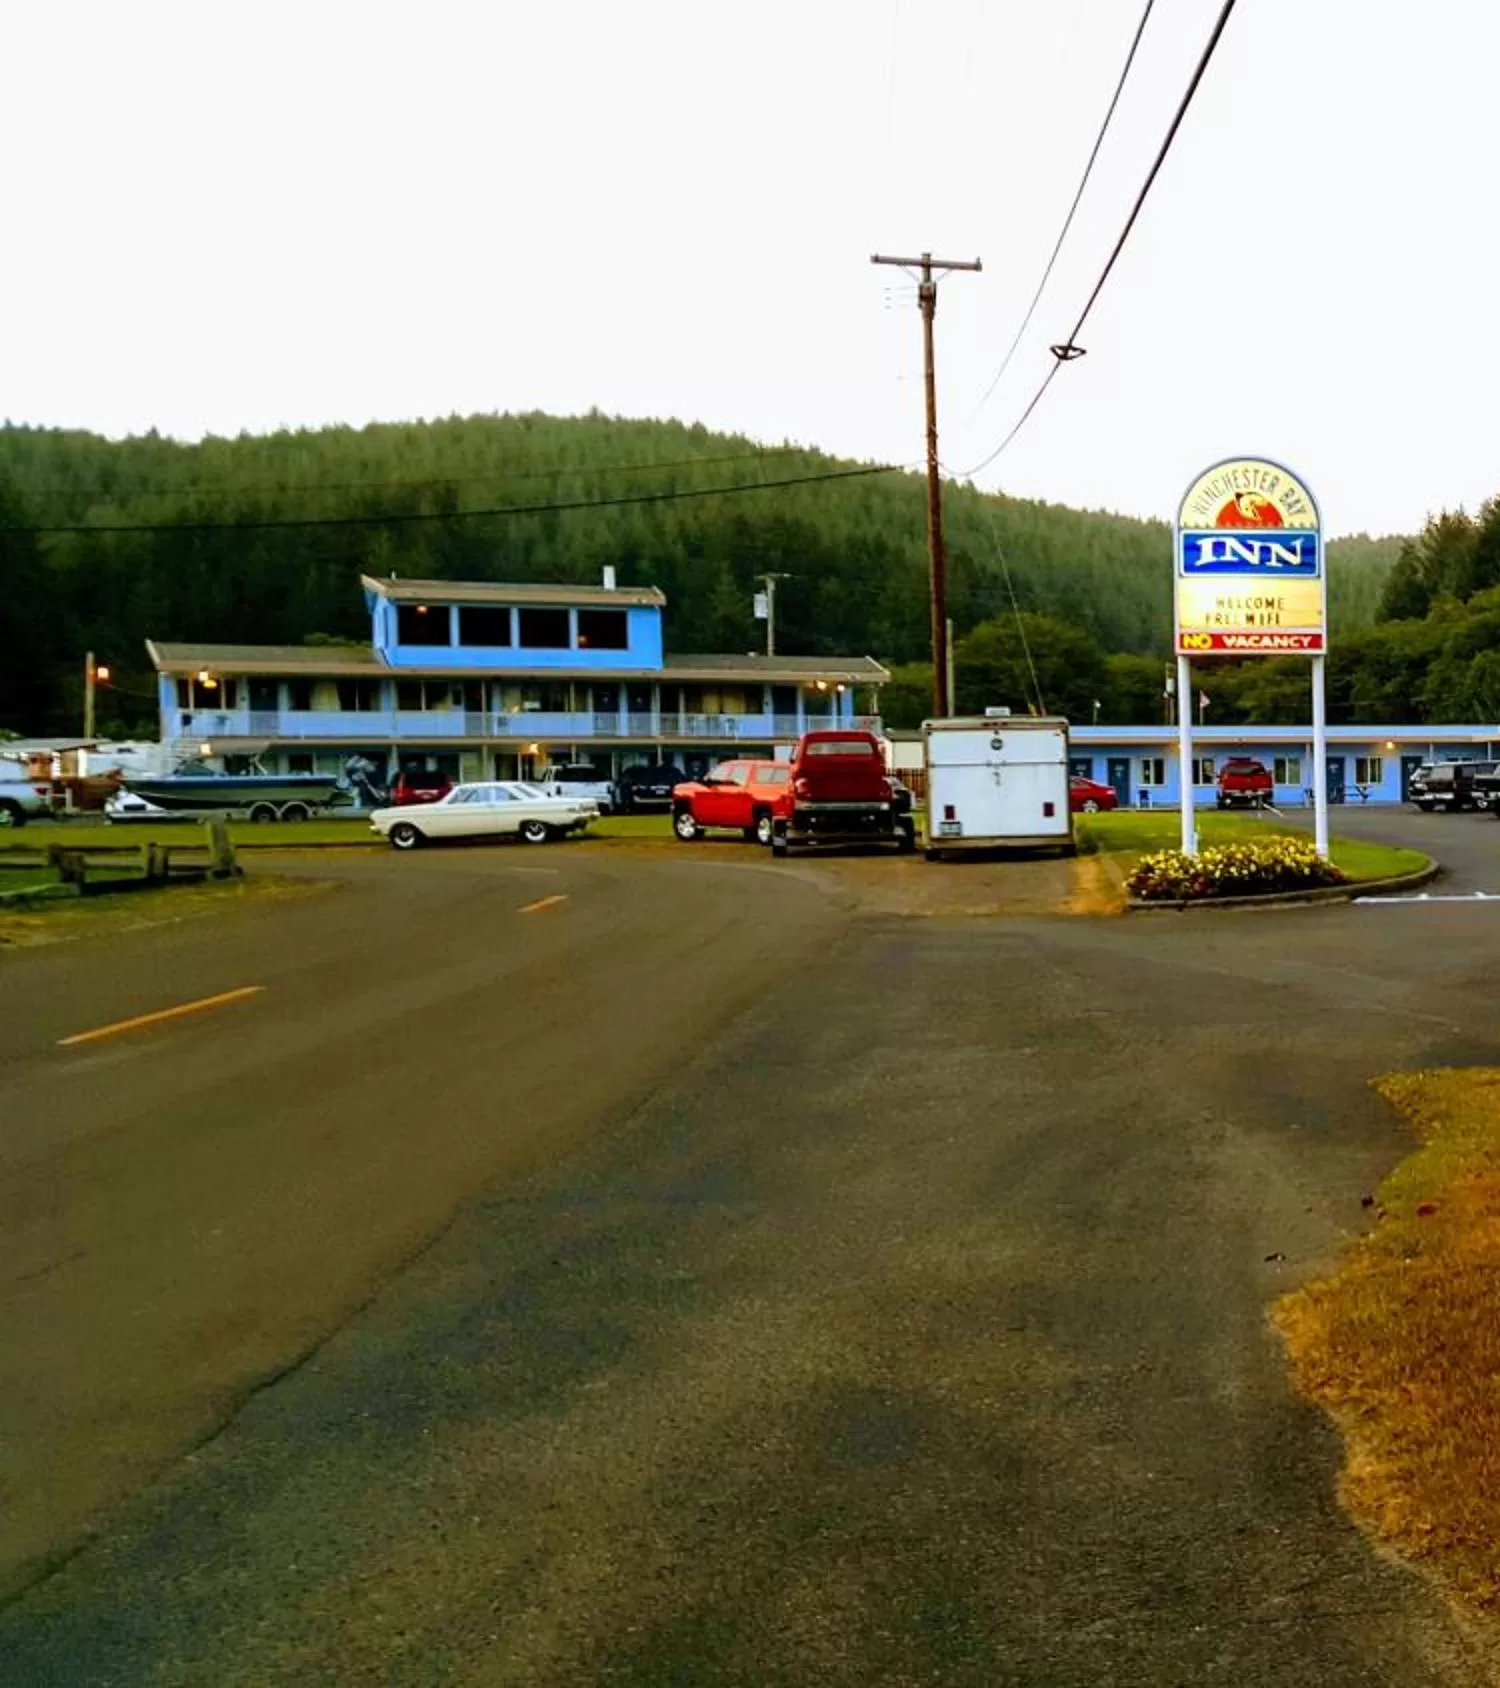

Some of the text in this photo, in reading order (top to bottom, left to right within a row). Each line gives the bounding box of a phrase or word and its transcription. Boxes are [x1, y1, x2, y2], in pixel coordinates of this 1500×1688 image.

[1191, 468, 1308, 517] WINCHESTER BAY
[1194, 536, 1305, 568] INN
[1183, 632, 1312, 649] NO VACANCY
